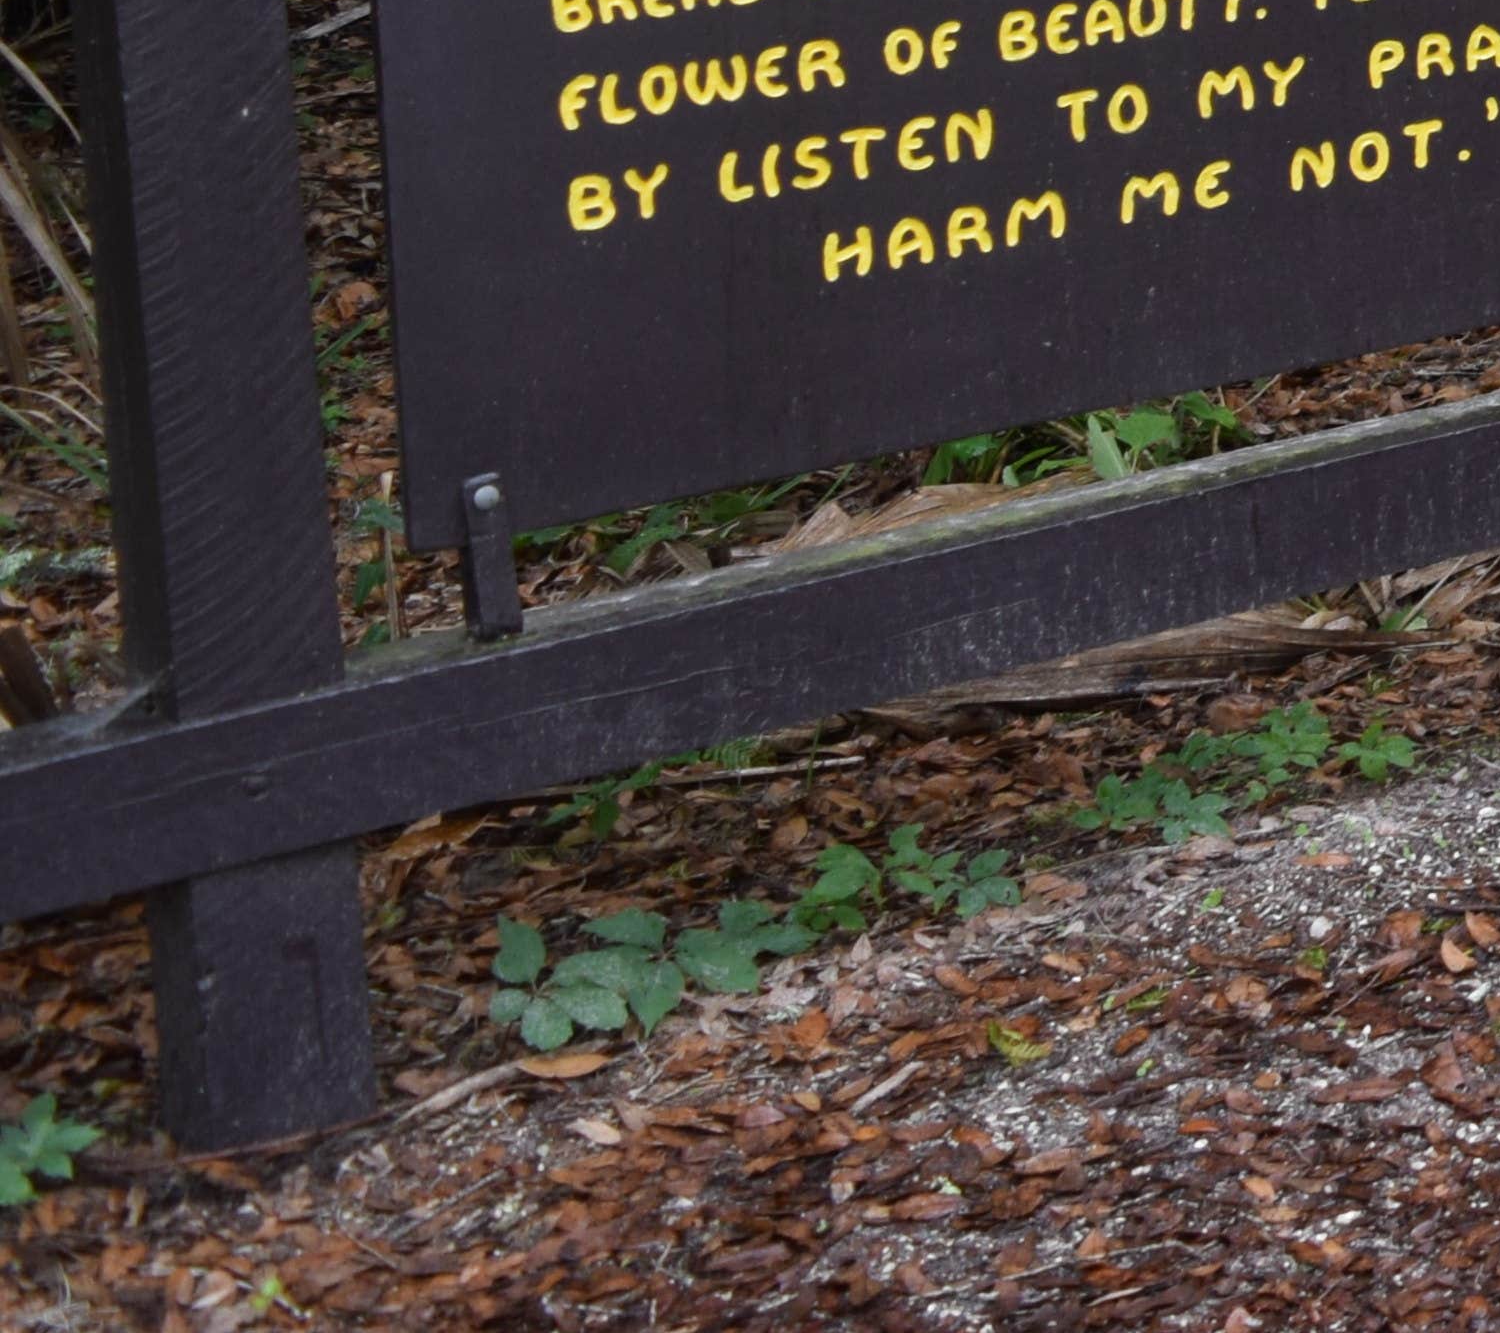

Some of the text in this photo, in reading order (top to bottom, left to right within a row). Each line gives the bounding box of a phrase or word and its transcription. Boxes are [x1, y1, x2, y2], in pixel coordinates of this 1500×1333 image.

[558, 39, 846, 130] FLOWER
[883, 20, 961, 75] OF
[567, 163, 669, 231] BY
[718, 108, 994, 203] LISTEN
[1056, 84, 1149, 142] TO
[1197, 56, 1305, 117] MY
[822, 191, 1066, 280] HARM
[1120, 160, 1231, 224] ME
